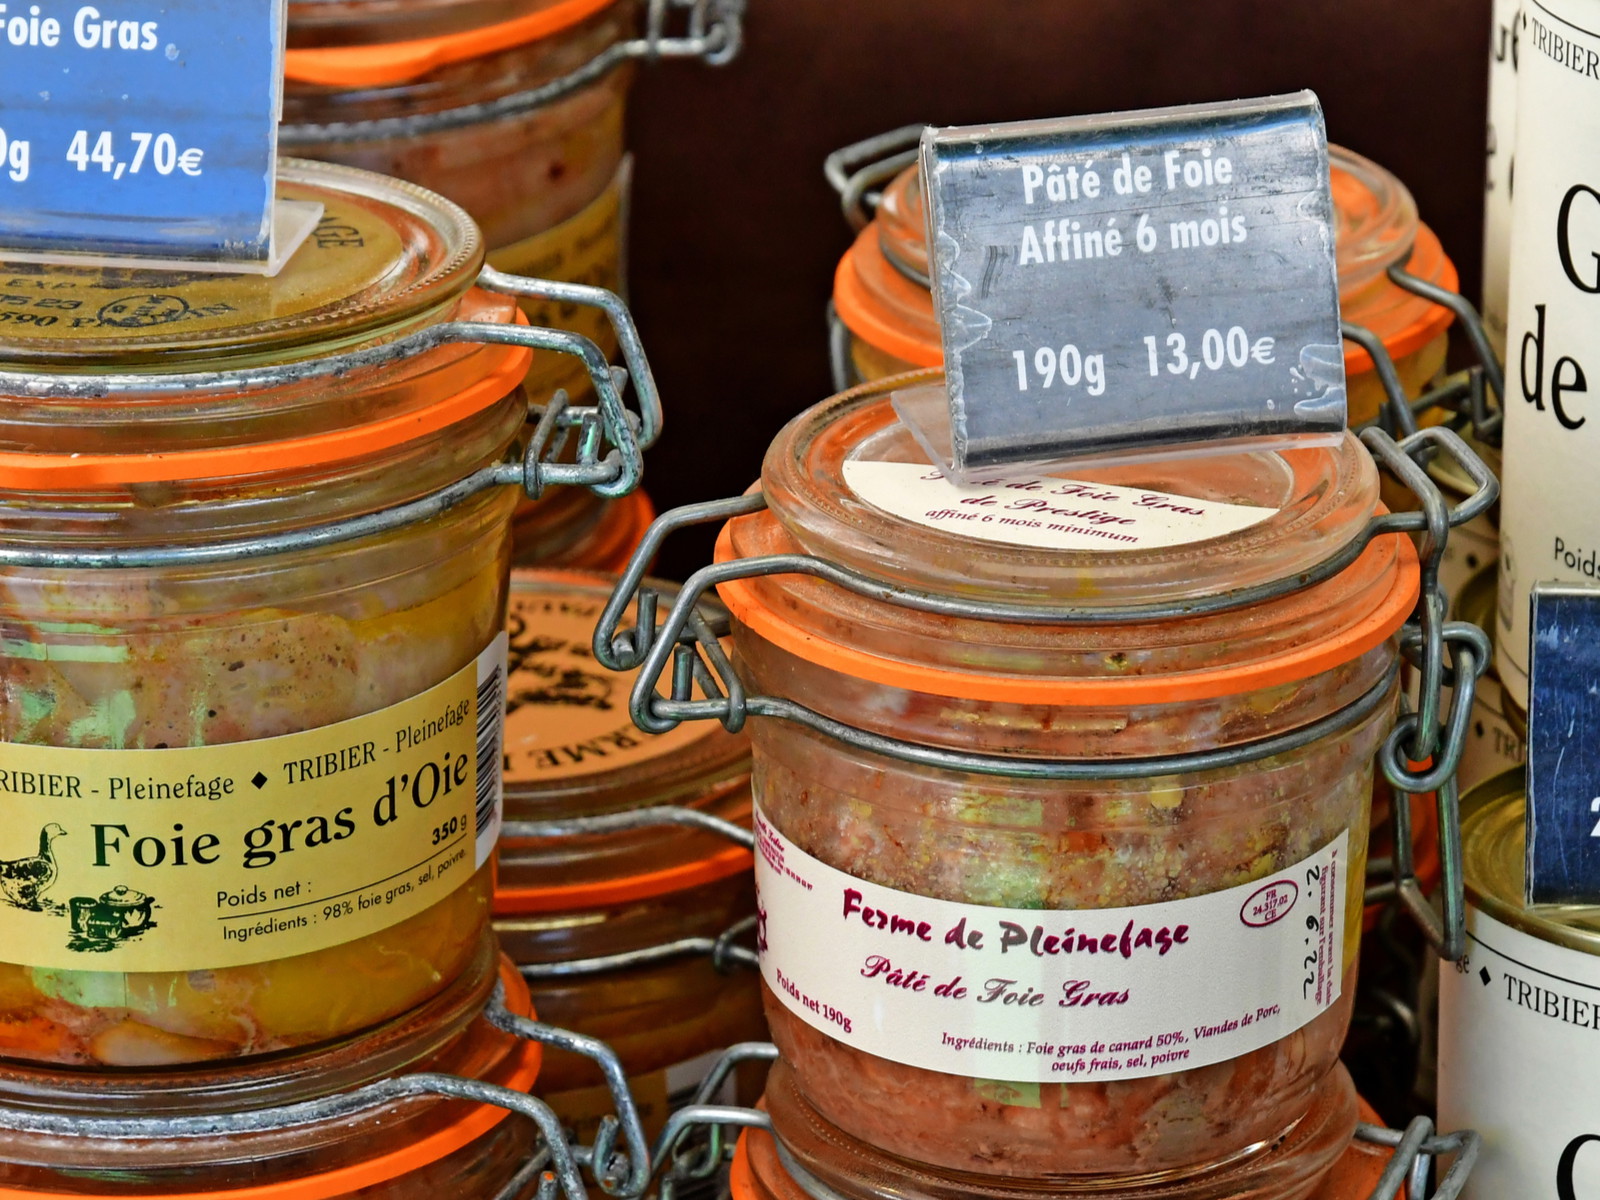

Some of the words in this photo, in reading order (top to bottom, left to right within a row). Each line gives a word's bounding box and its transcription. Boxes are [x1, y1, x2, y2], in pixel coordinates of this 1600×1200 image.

[74, 6, 158, 50] Gras
[1532, 16, 1600, 80] TRIBIER
[66, 130, 204, 180] 44,70€
[1022, 160, 1101, 205] Pâté
[1113, 152, 1152, 195] de
[1164, 147, 1233, 190] Foie
[1019, 217, 1123, 266] Affiné
[1136, 213, 1157, 253] 6
[1170, 206, 1248, 249] mois
[1012, 344, 1106, 396] 190g
[1143, 325, 1276, 380] 13,00€
[1520, 304, 1588, 430] de
[925, 508, 978, 521] affiné
[981, 514, 996, 523] 6
[998, 516, 1043, 529] mois
[1047, 523, 1139, 543] minimum
[960, 495, 999, 506] de
[1004, 498, 1137, 525] Prestige
[1050, 484, 1121, 501] Foie
[1132, 493, 1206, 516] Gras
[108, 774, 235, 801] Pleinefage
[283, 741, 376, 784] TRIBIER
[395, 699, 470, 753] Pleinefage
[90, 823, 220, 867] Foie
[242, 806, 356, 869] gras
[373, 751, 468, 827] d'Oie
[217, 884, 267, 908] Poids
[274, 881, 301, 900] net
[431, 816, 458, 845] 350
[460, 814, 468, 831] g
[223, 915, 308, 942] Ingrédients
[322, 901, 353, 921] 98%
[358, 893, 382, 911] foie
[385, 881, 415, 904] gras,
[843, 888, 932, 942] Ferme
[944, 916, 984, 950] de
[999, 919, 1190, 959] Pleinefage
[776, 968, 800, 1002] Poids
[802, 994, 820, 1015] net
[822, 1003, 853, 1034] 190g
[860, 954, 931, 992] Pâté
[934, 976, 967, 999] de
[977, 978, 1045, 1006] Foie
[1058, 979, 1130, 1008] Gras
[941, 1032, 1014, 1053] Ingrédients
[1026, 1041, 1054, 1055] Foie
[1057, 1044, 1087, 1058] gras
[1090, 1041, 1106, 1054] de
[1108, 1036, 1153, 1053] canard
[1194, 1019, 1239, 1040] Viandes
[1241, 1013, 1253, 1028] de
[1256, 1003, 1281, 1022] Porc,
[1051, 1058, 1086, 1075] oeufs
[1151, 1048, 1190, 1069] poivre
